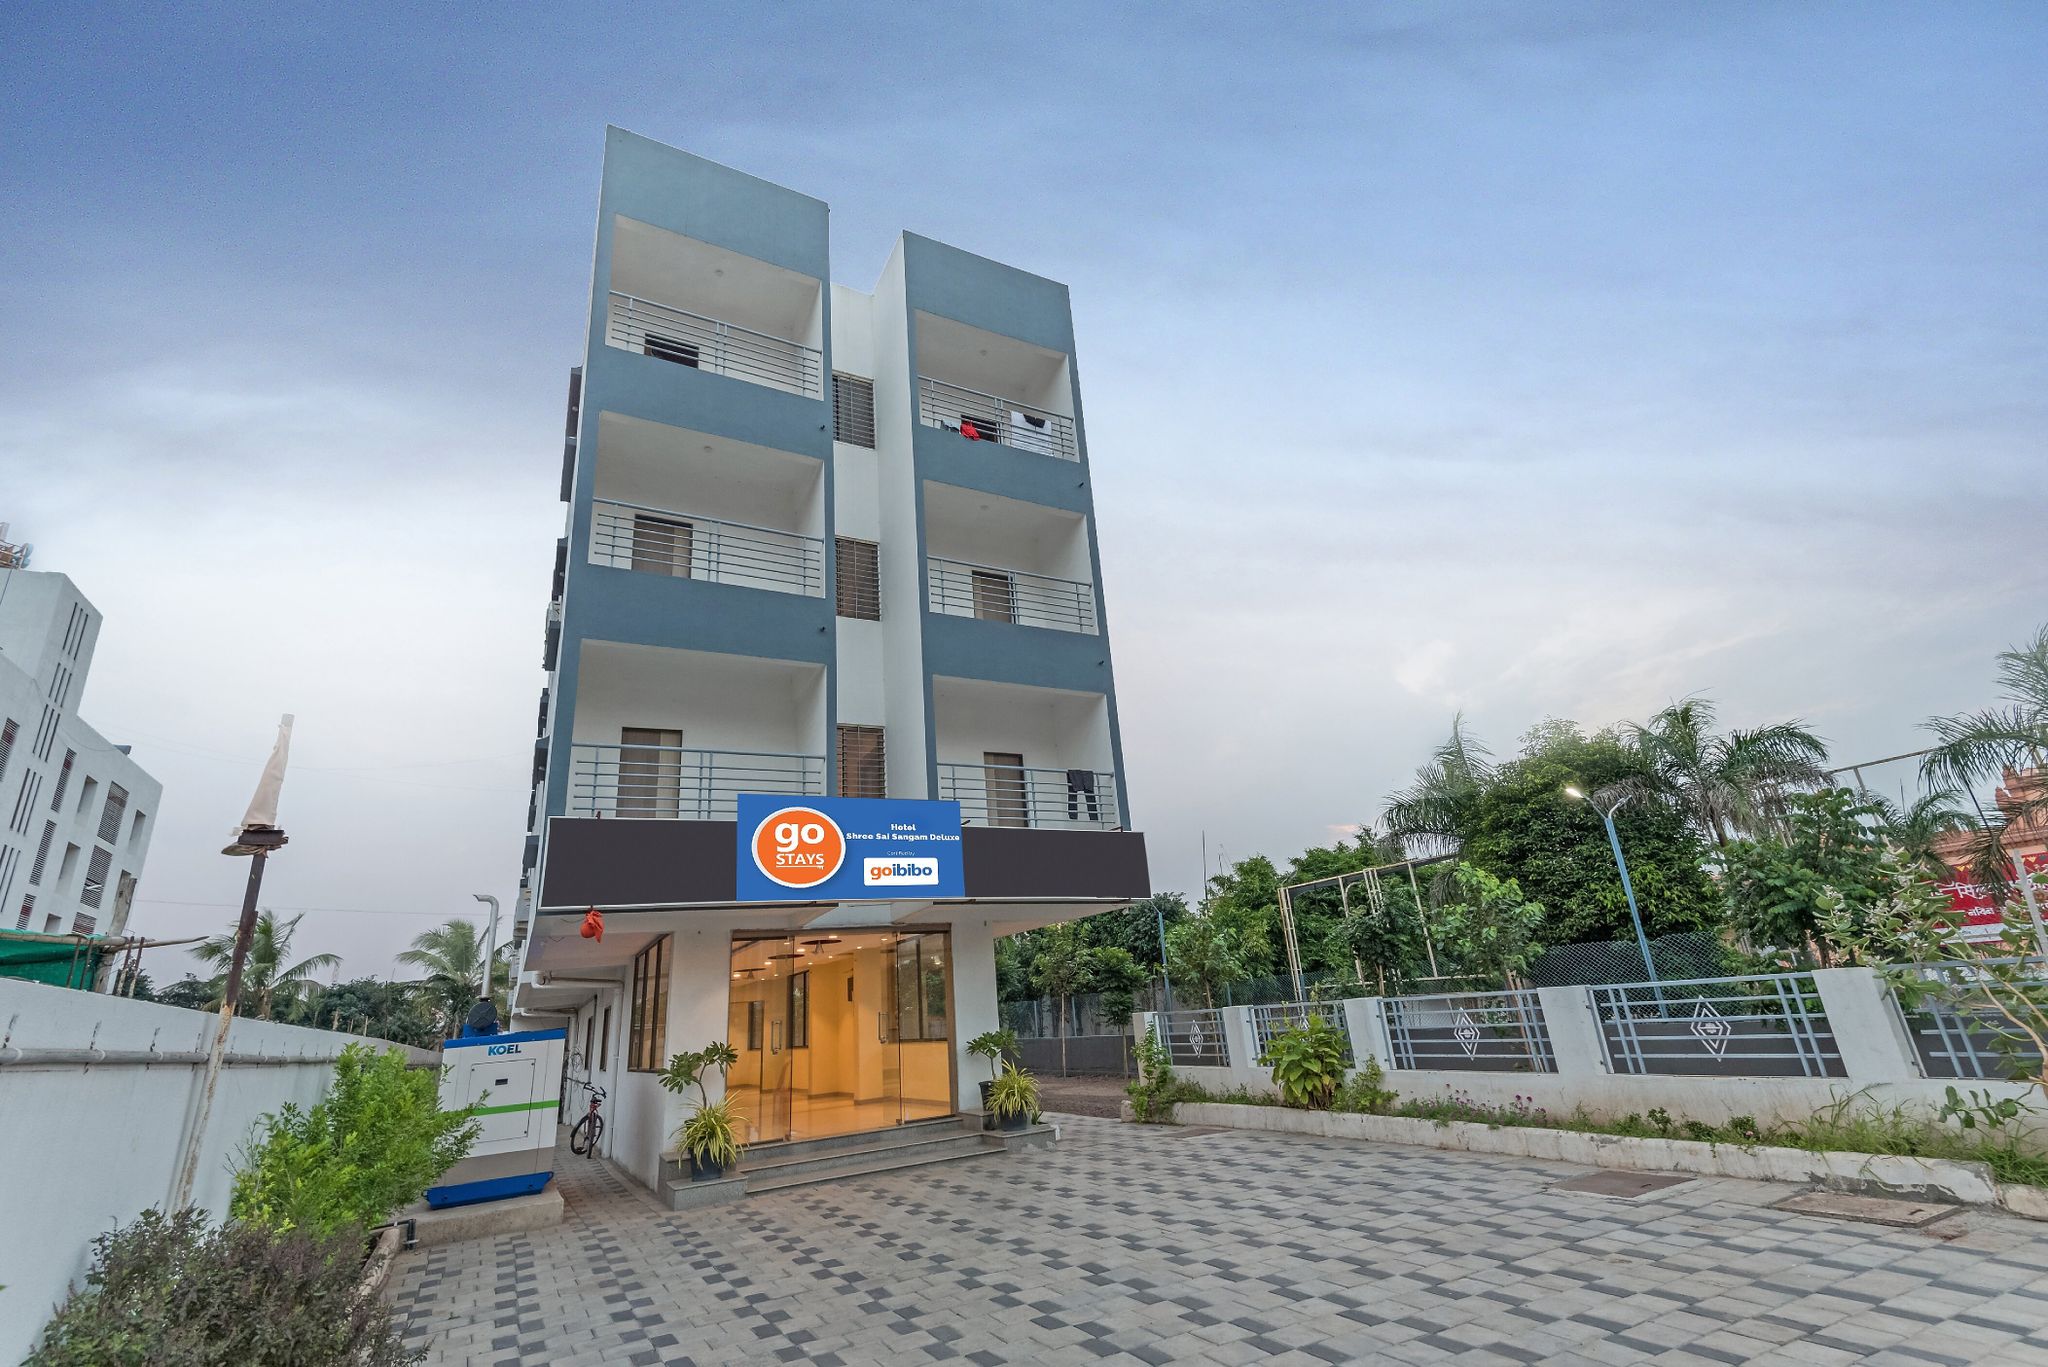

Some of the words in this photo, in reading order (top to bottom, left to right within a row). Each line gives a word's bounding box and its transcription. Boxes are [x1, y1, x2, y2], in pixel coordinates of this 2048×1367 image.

[890, 823, 917, 831] Hotel
[774, 822, 825, 852] go
[846, 832, 874, 840] Shree
[891, 833, 928, 842] Sangam
[929, 833, 960, 841] Deluxe
[775, 853, 825, 865] STAYS
[870, 863, 933, 880] goibibo
[488, 1043, 522, 1057] KOEL
